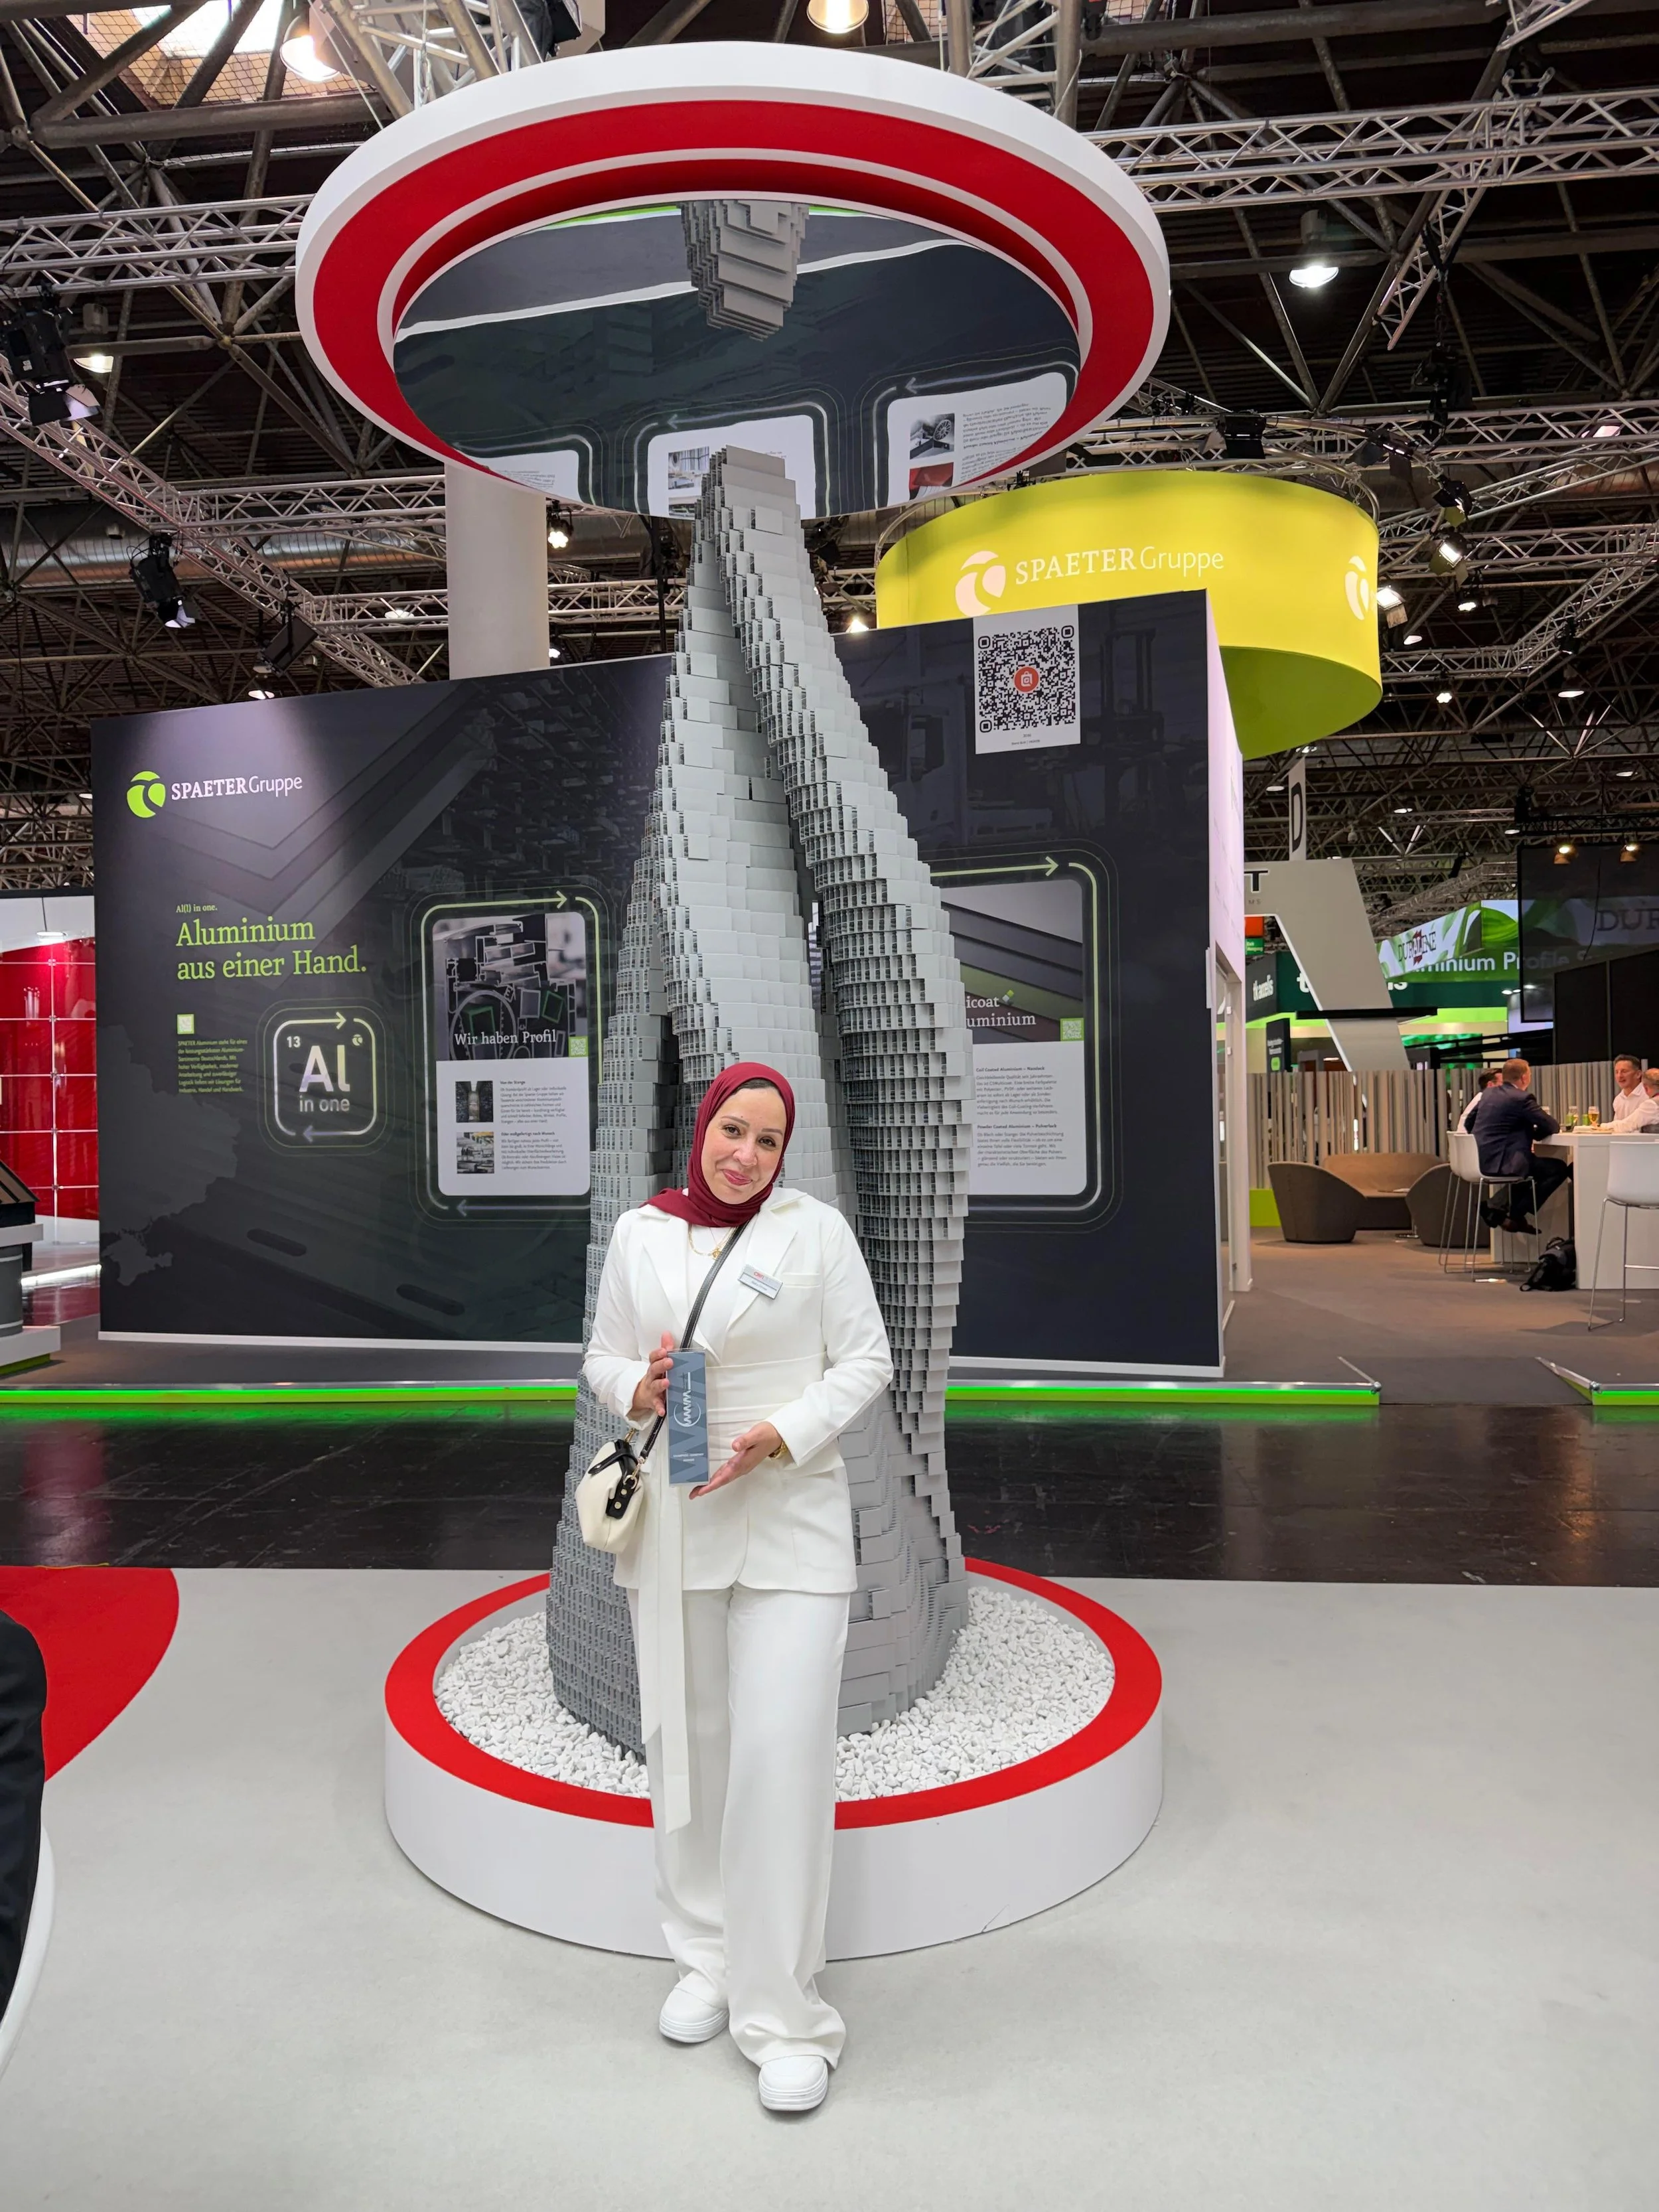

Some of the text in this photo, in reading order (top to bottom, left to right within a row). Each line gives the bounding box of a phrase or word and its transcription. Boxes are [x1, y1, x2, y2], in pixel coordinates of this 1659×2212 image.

[176, 916, 315, 946] Aluminium
[1398, 931, 1437, 962] DURALINE
[177, 944, 366, 980] aus einer Hand.
[966, 995, 1000, 1008] icoat
[966, 1012, 1037, 1027] uminium
[287, 1036, 301, 1048] 13
[455, 1029, 557, 1045] Wir haben Profil
[299, 1045, 350, 1092] Al
[299, 1096, 350, 1112] in one
